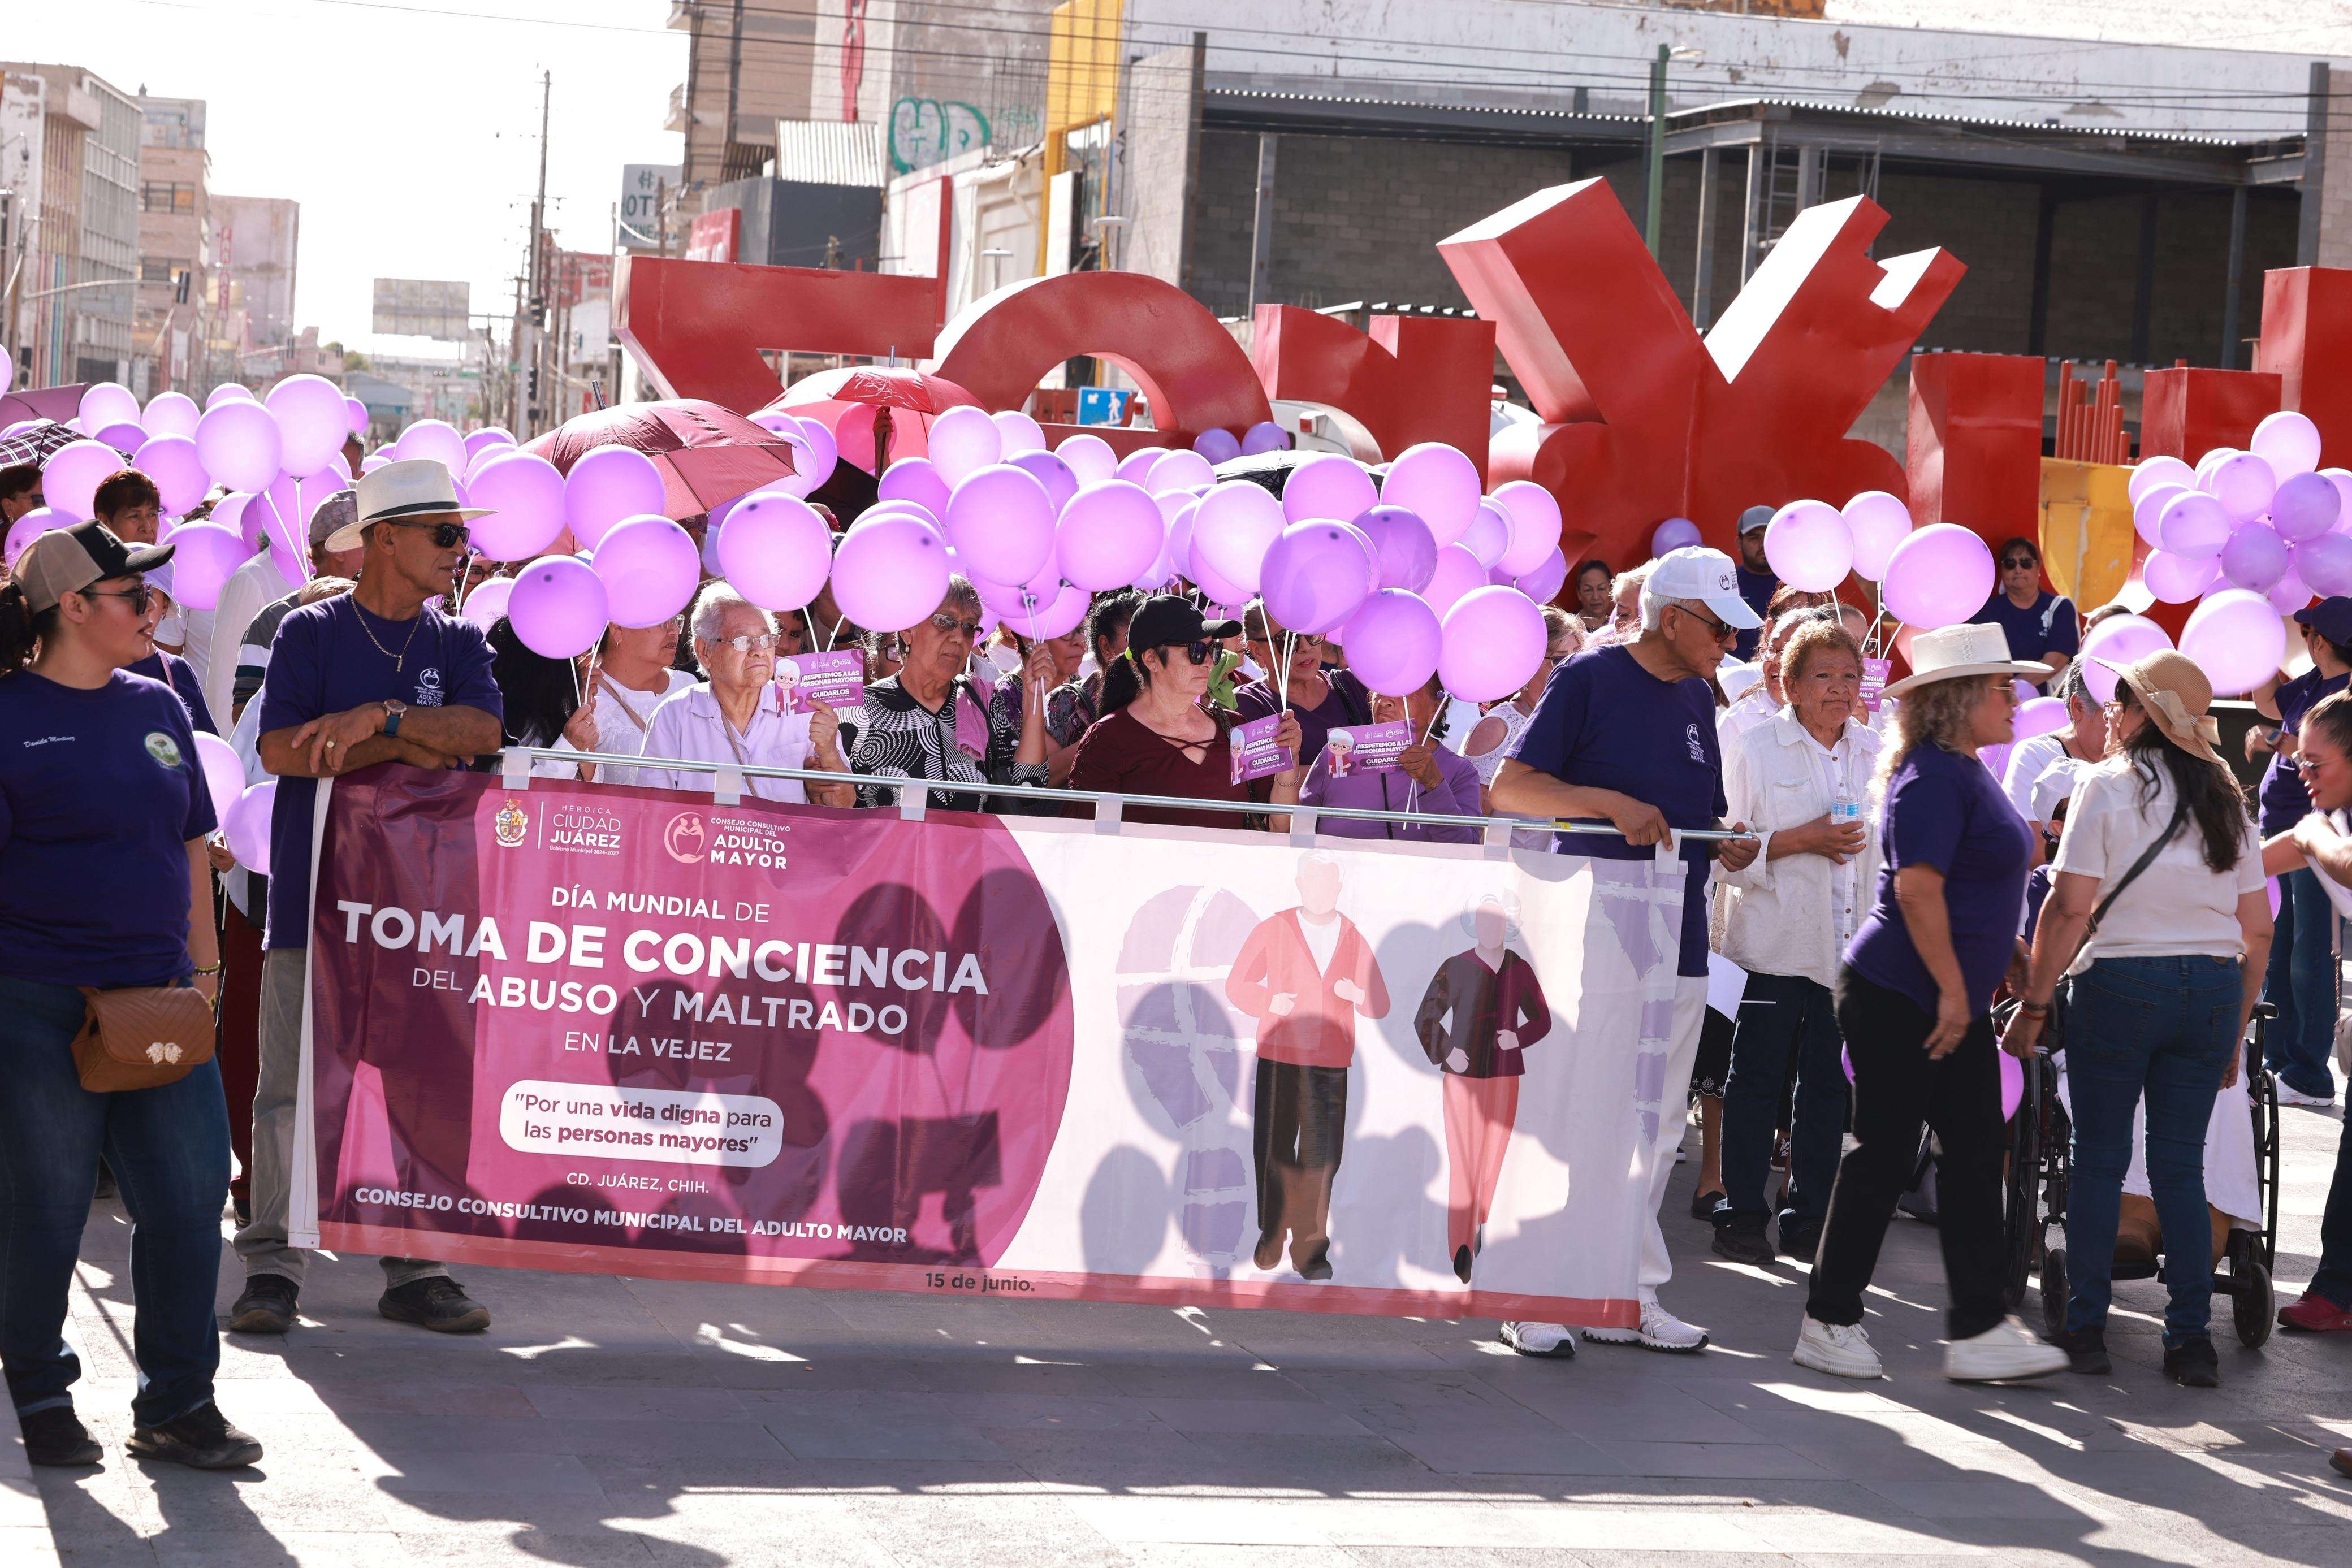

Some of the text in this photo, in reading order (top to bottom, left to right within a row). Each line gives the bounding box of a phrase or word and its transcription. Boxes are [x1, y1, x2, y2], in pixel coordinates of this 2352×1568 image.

[96, 525, 122, 548] A
[800, 678, 831, 688] PERSONAS
[802, 671, 842, 682] ¡RESPETEMOS
[417, 698, 442, 707] MAYOR
[418, 694, 441, 702] ADULTO
[812, 688, 850, 698] CUIDARLOS
[23, 738, 48, 748] Daniela
[1244, 746, 1266, 756] PERSONAS
[1246, 737, 1273, 751] ¡RESPETEMOS
[1356, 742, 1396, 751] ¡RESPETEMOS
[1252, 754, 1279, 766] CUIDARLOS
[562, 805, 611, 815] HEROICA
[552, 813, 621, 832] CIUDAD
[710, 817, 790, 832] CONSEJO CONSULTIVO
[724, 825, 763, 834] MUNICIPAL
[550, 829, 621, 848] JUÁREZ
[714, 834, 785, 854] ADULTO
[710, 850, 787, 869] MAYOR
[551, 883, 771, 924] DÍA MUNDIAL DE
[337, 899, 990, 996] TOMA DE CONCIENCIA
[413, 967, 909, 1036] DEL ABUSO Y MALTRADO
[564, 1031, 732, 1062] EN LA VEJEZ
[515, 1093, 772, 1129] "Por una vida digna para
[524, 1120, 759, 1154] las personas mayores"
[566, 1172, 710, 1194] CD. JUÁREZ, CHIH.
[354, 1186, 907, 1244] CONSEJO CONSULTIVO MUNICIPAL DEL ADULTO MAYOR
[926, 1272, 1036, 1293] 15 de junio.
